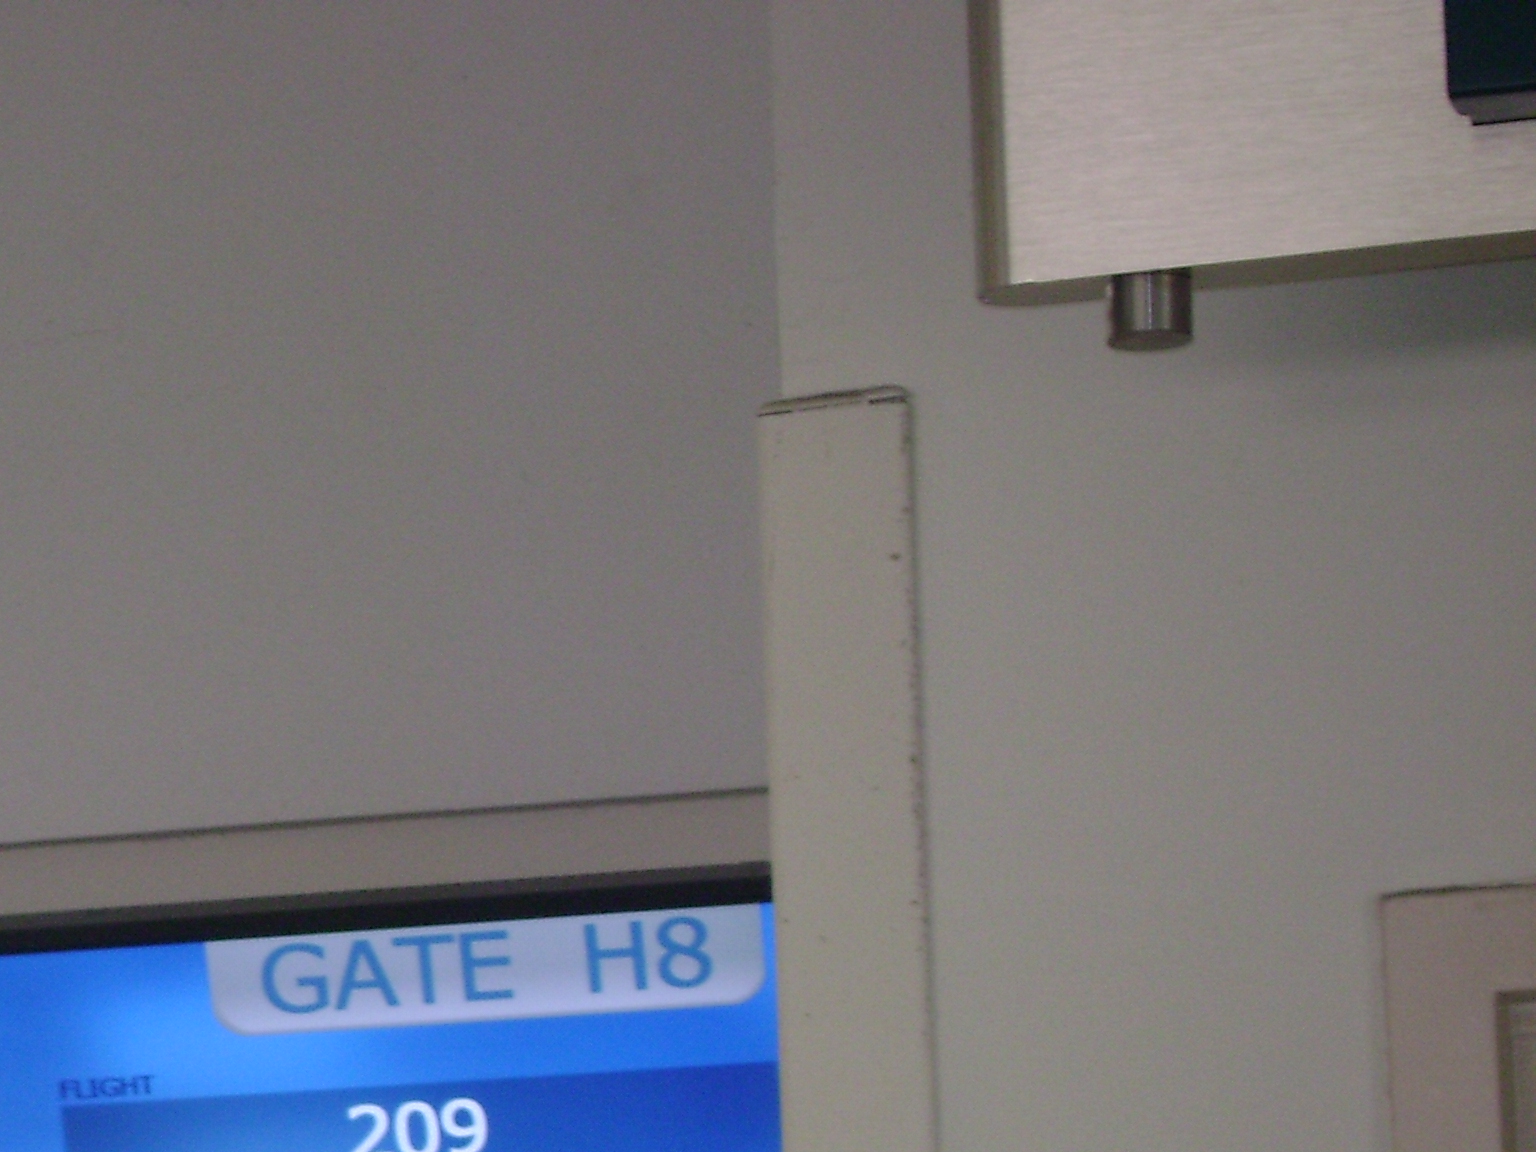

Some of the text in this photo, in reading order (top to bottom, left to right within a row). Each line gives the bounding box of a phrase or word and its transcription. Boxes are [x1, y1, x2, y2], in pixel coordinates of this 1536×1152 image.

[263, 915, 714, 1015] GATE H8
[59, 1074, 154, 1099] FLIGHT
